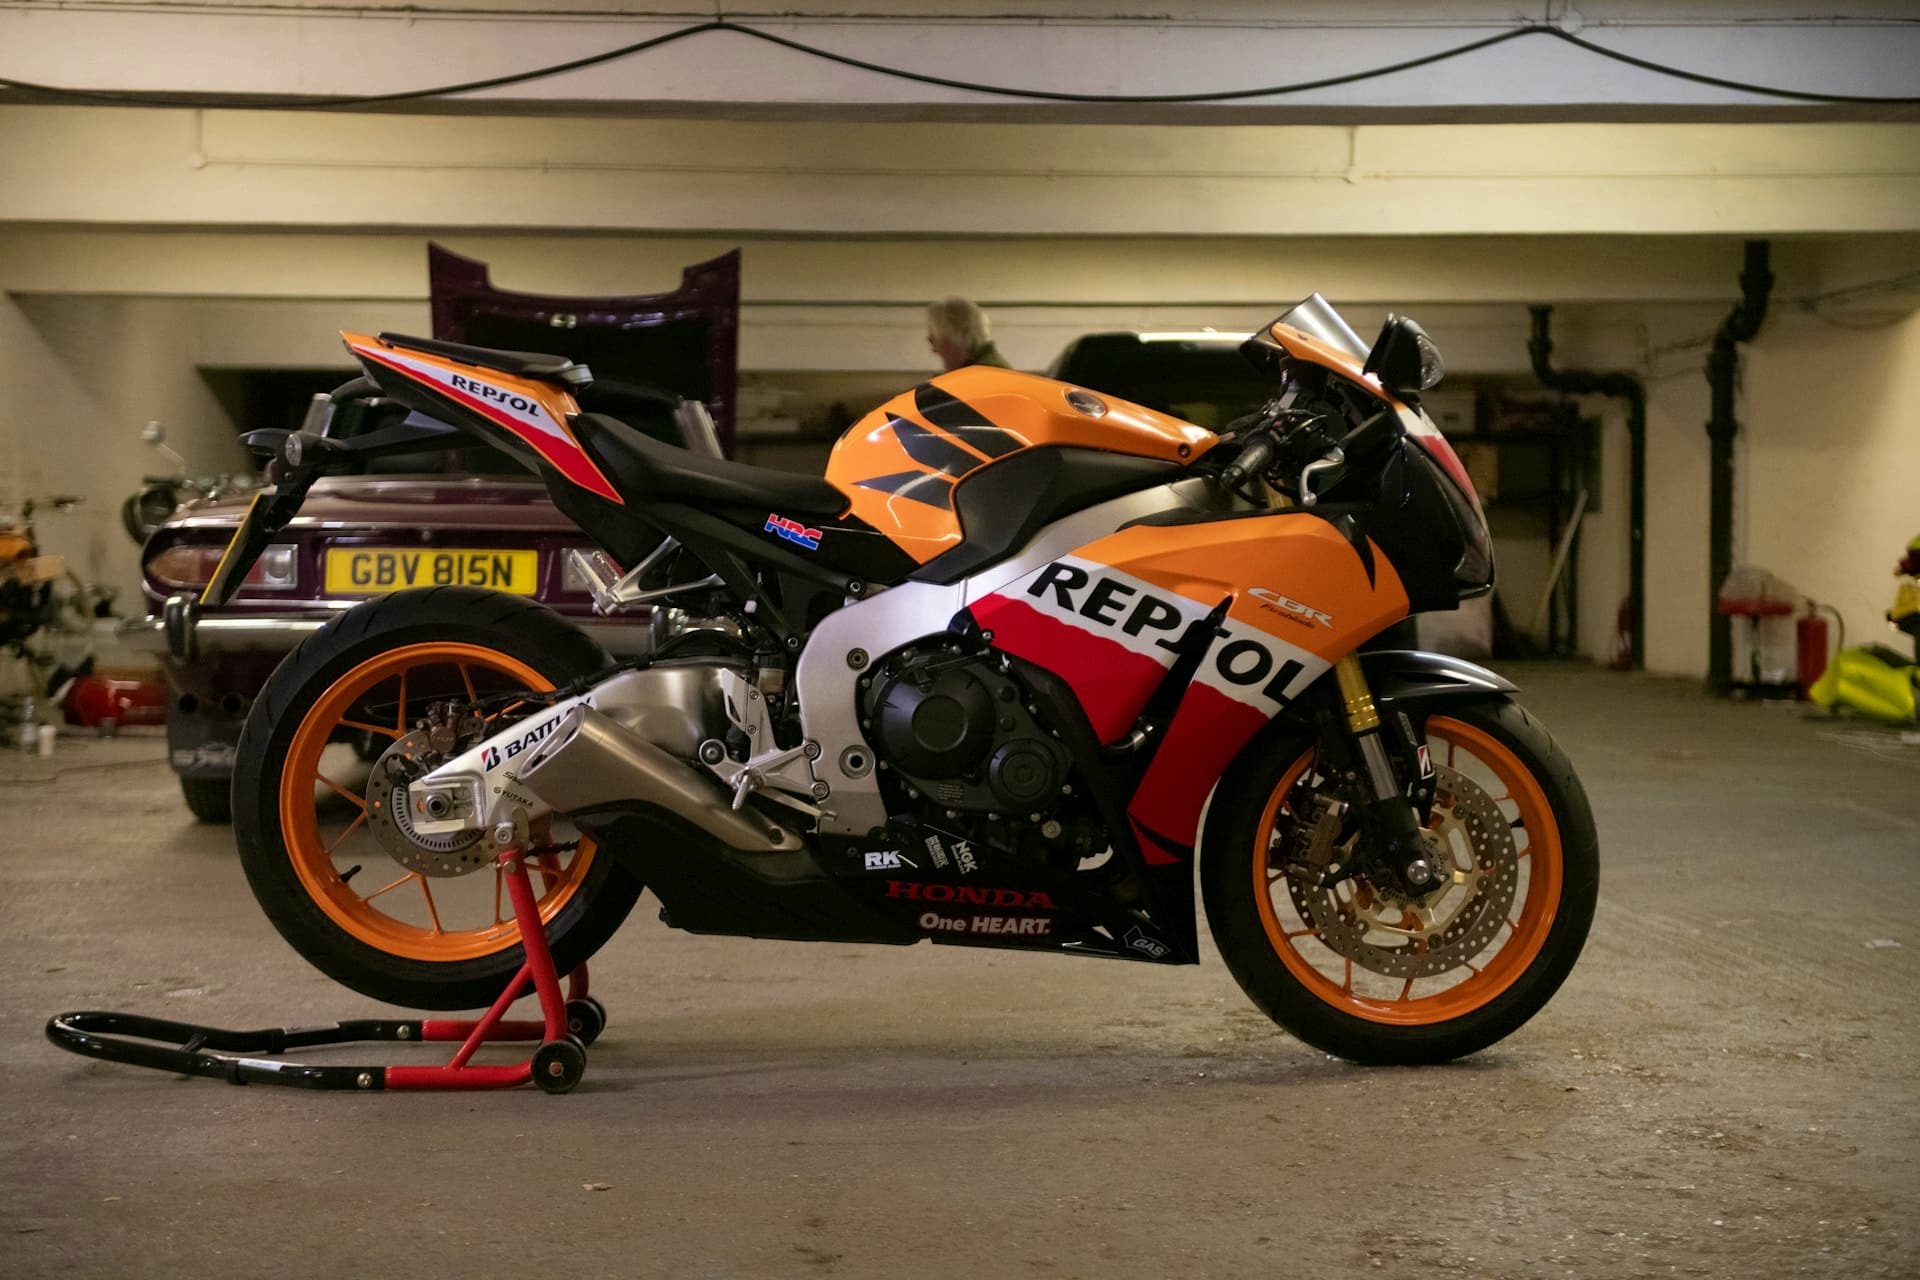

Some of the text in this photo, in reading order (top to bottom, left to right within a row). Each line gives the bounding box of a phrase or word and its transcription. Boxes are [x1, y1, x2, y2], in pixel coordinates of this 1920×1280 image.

[451, 373, 540, 418] REPSOL
[764, 513, 823, 551] HRC
[351, 553, 513, 586] GBV 815N
[1247, 586, 1335, 630] CBR
[502, 790, 534, 808] YUTAKA
[864, 850, 901, 867] RK
[954, 840, 978, 873] NGK
[885, 880, 1056, 909] HONDA
[919, 913, 966, 932] One
[1132, 938, 1165, 956] GAS
